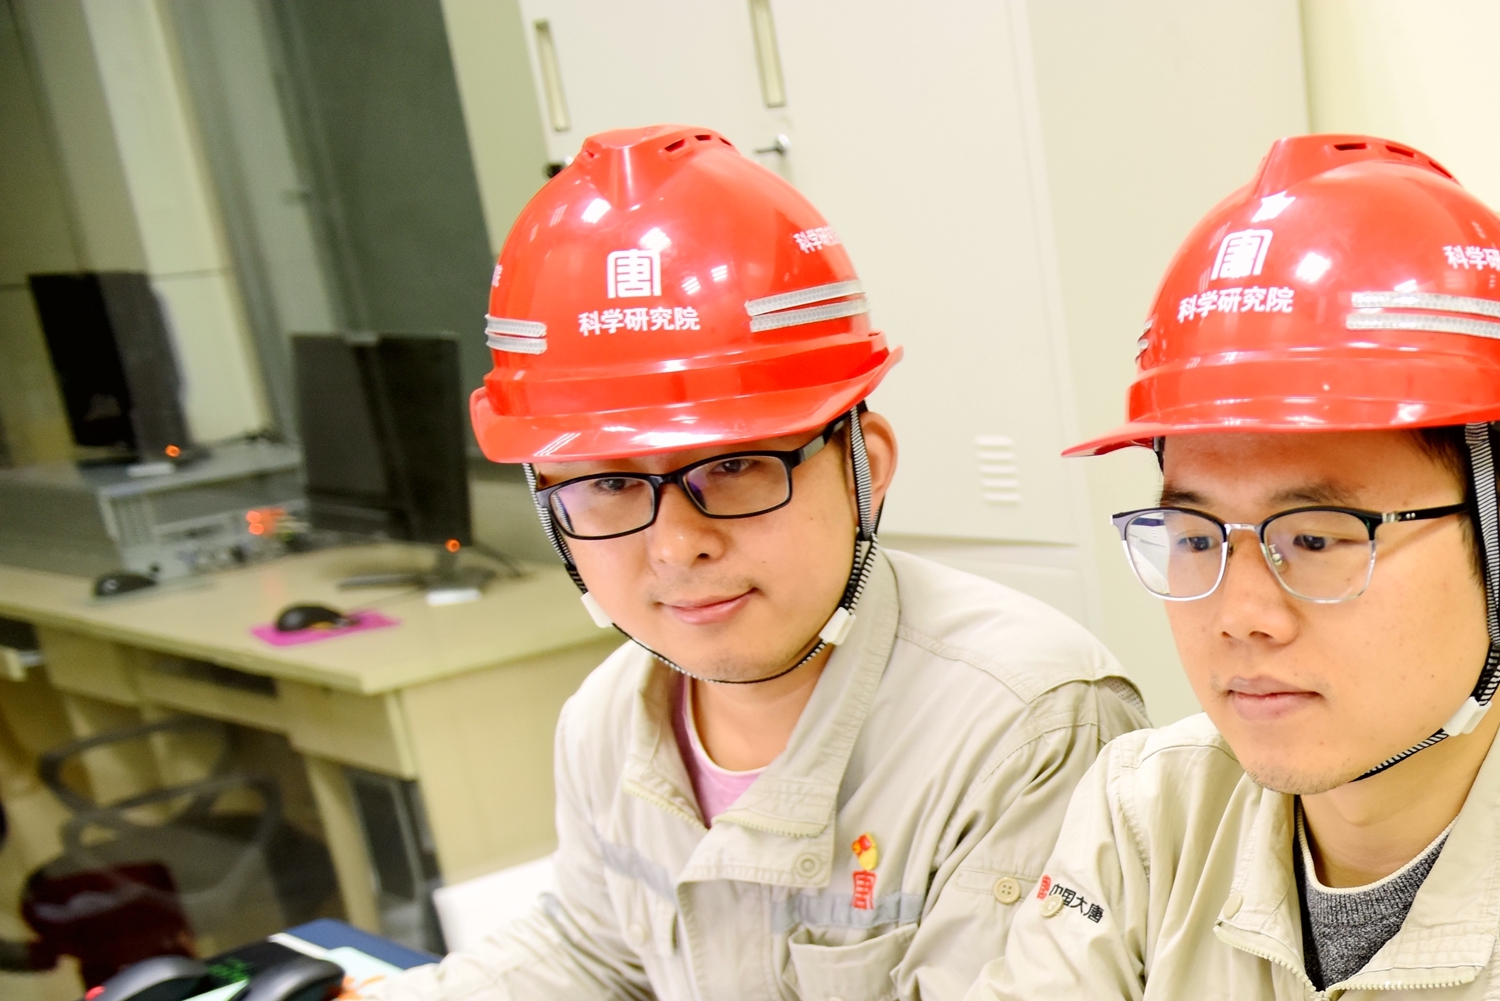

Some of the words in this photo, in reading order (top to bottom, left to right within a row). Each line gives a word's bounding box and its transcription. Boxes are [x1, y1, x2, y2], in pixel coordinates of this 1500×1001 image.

[578, 306, 701, 337] 科学研究院
[1177, 286, 1295, 324] 科学研究院
